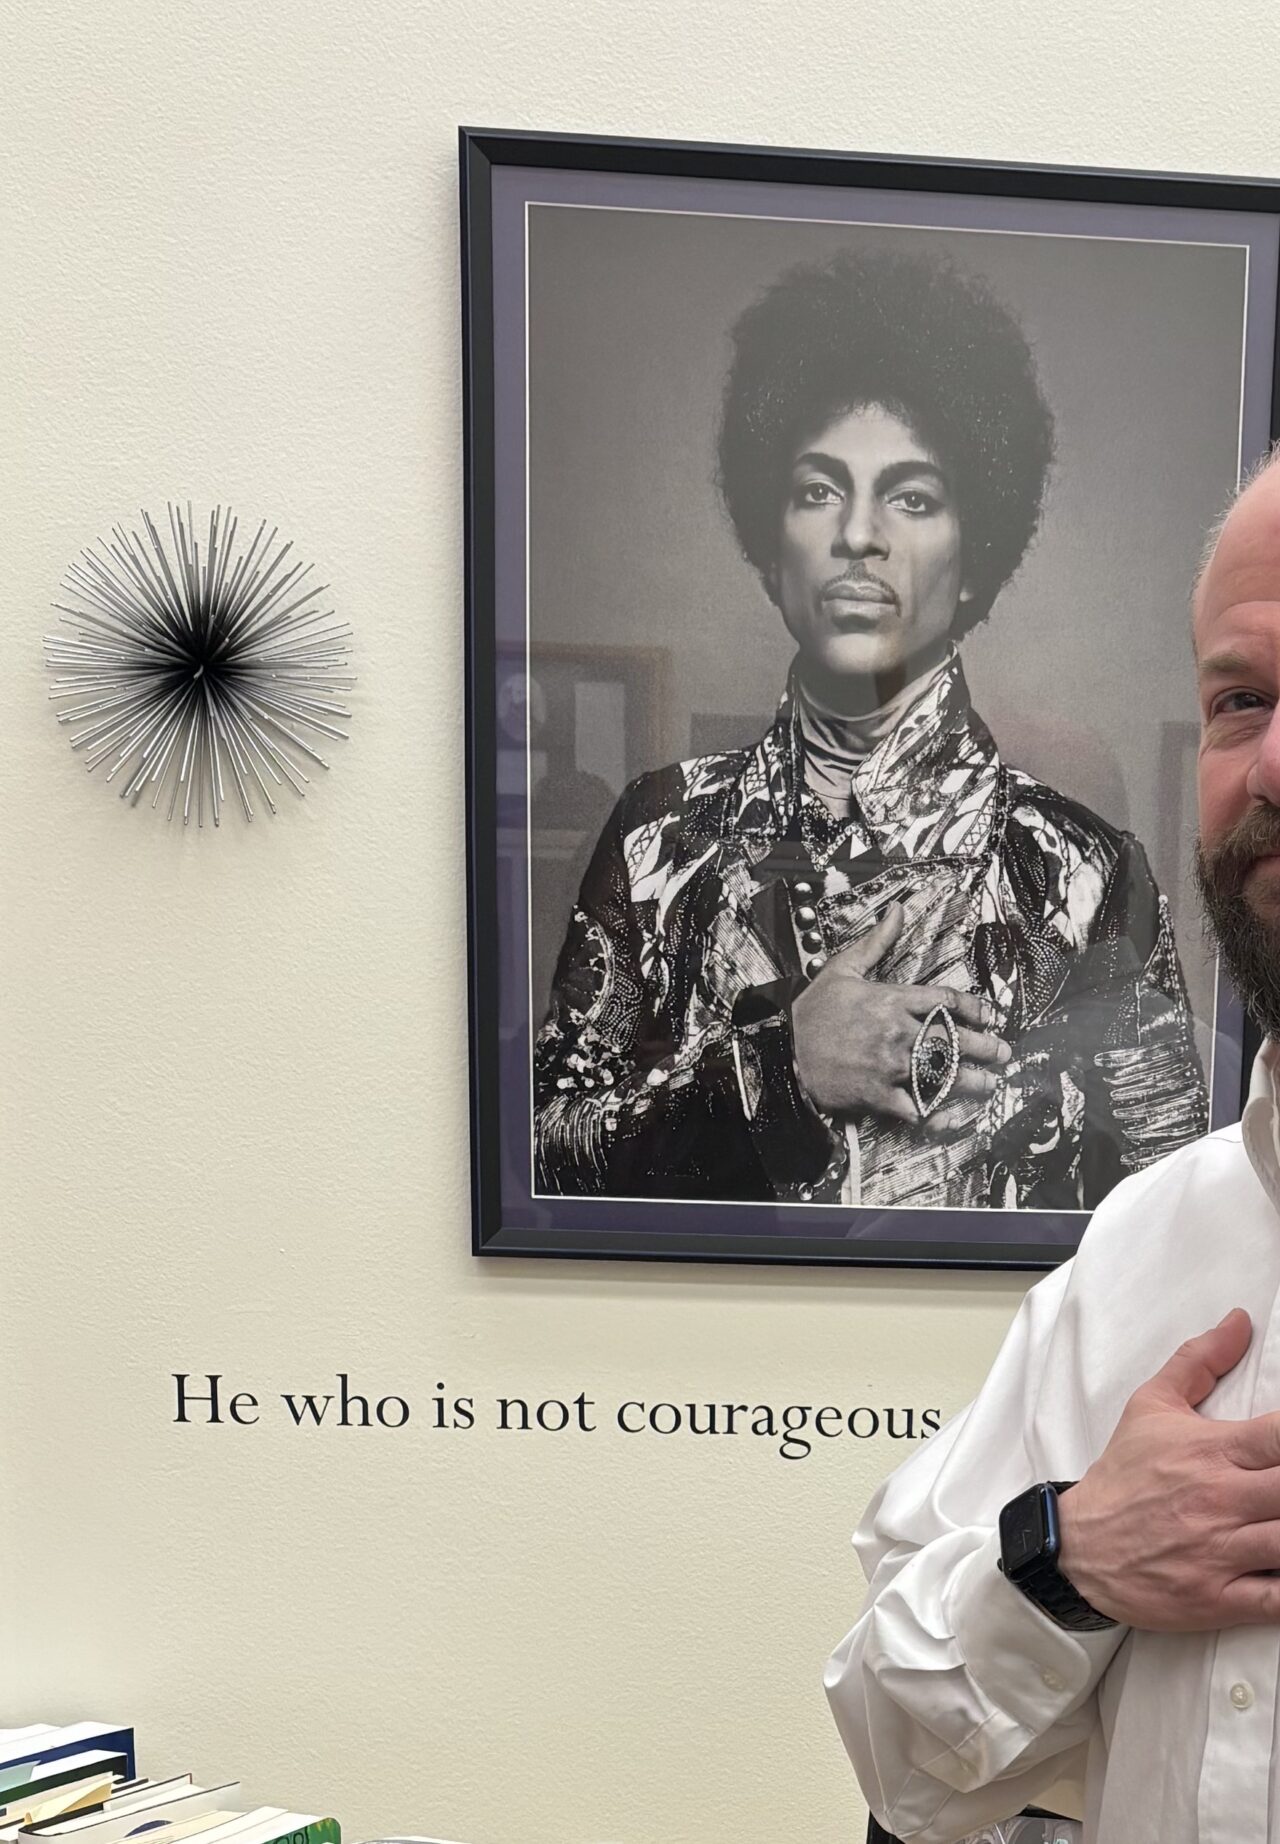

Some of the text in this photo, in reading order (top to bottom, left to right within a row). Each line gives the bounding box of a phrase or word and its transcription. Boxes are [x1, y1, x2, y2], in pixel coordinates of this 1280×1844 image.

[171, 1373, 941, 1460] He who is not courageous
